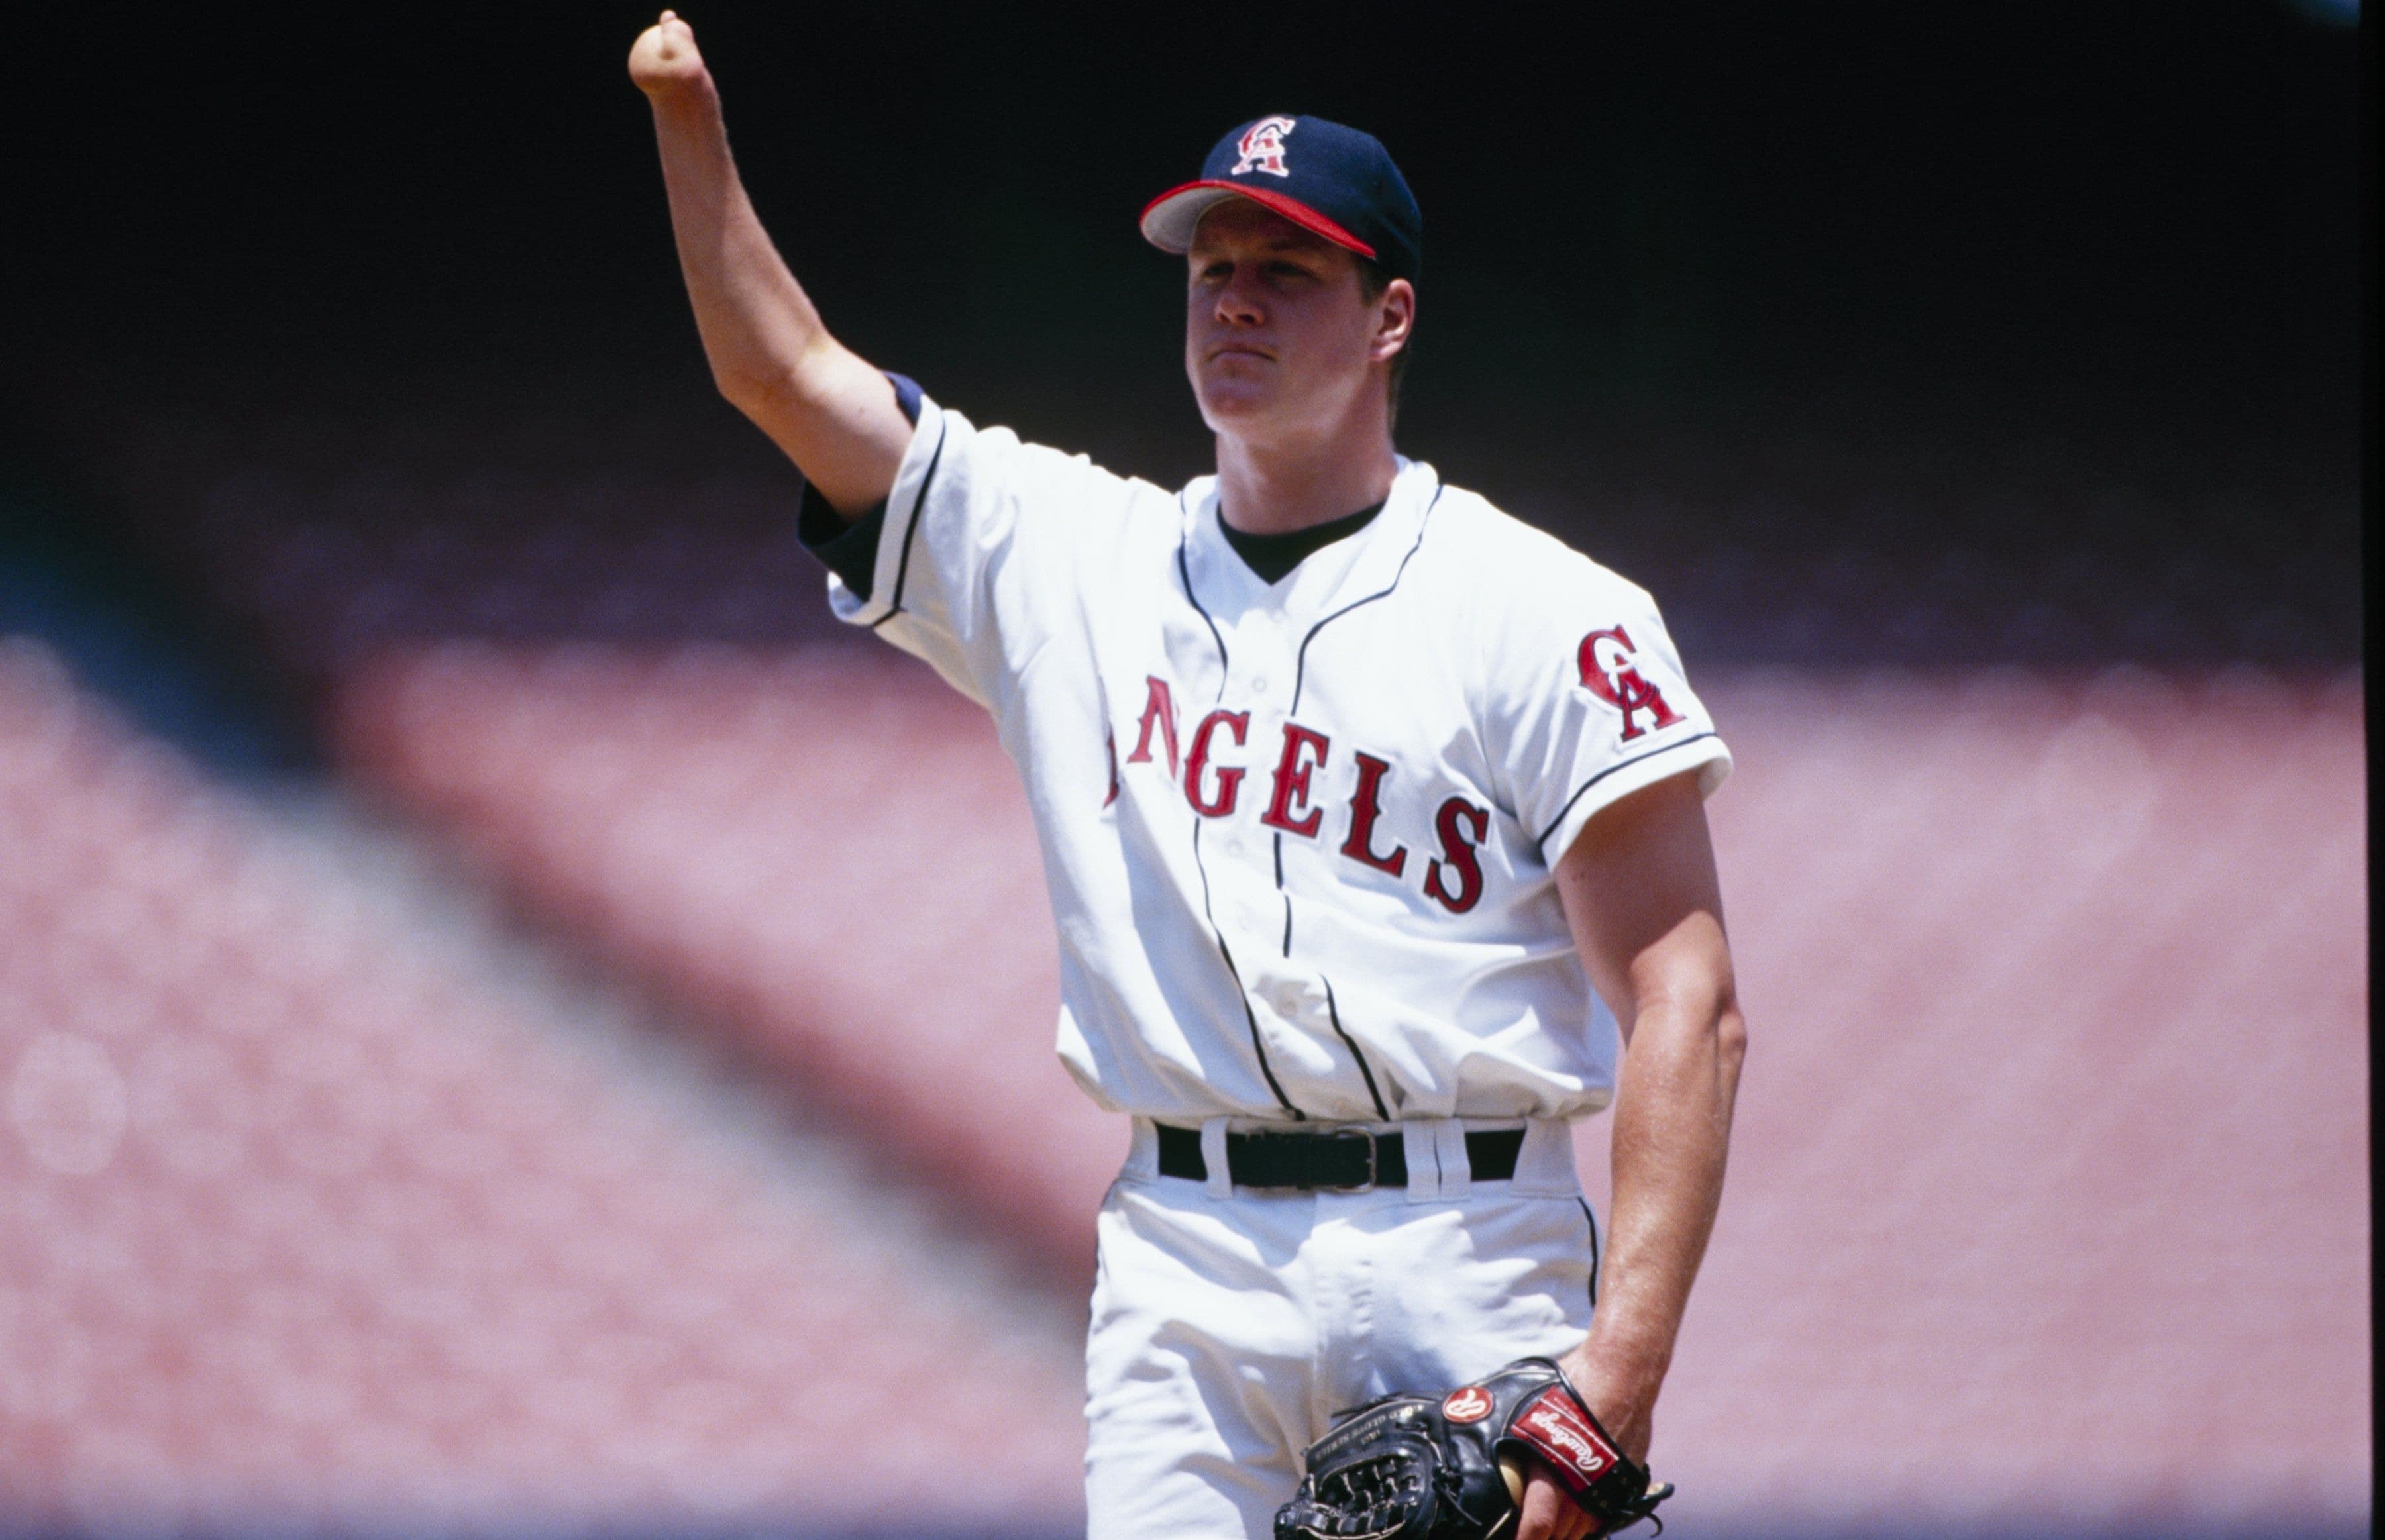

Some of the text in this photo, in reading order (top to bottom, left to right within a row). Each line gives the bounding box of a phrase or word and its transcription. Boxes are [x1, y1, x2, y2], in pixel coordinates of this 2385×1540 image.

[1231, 116, 1296, 177] CA
[1577, 624, 1687, 743] CA
[1102, 674, 1490, 914] NGELS
[1530, 1410, 1603, 1470] Rawlings
